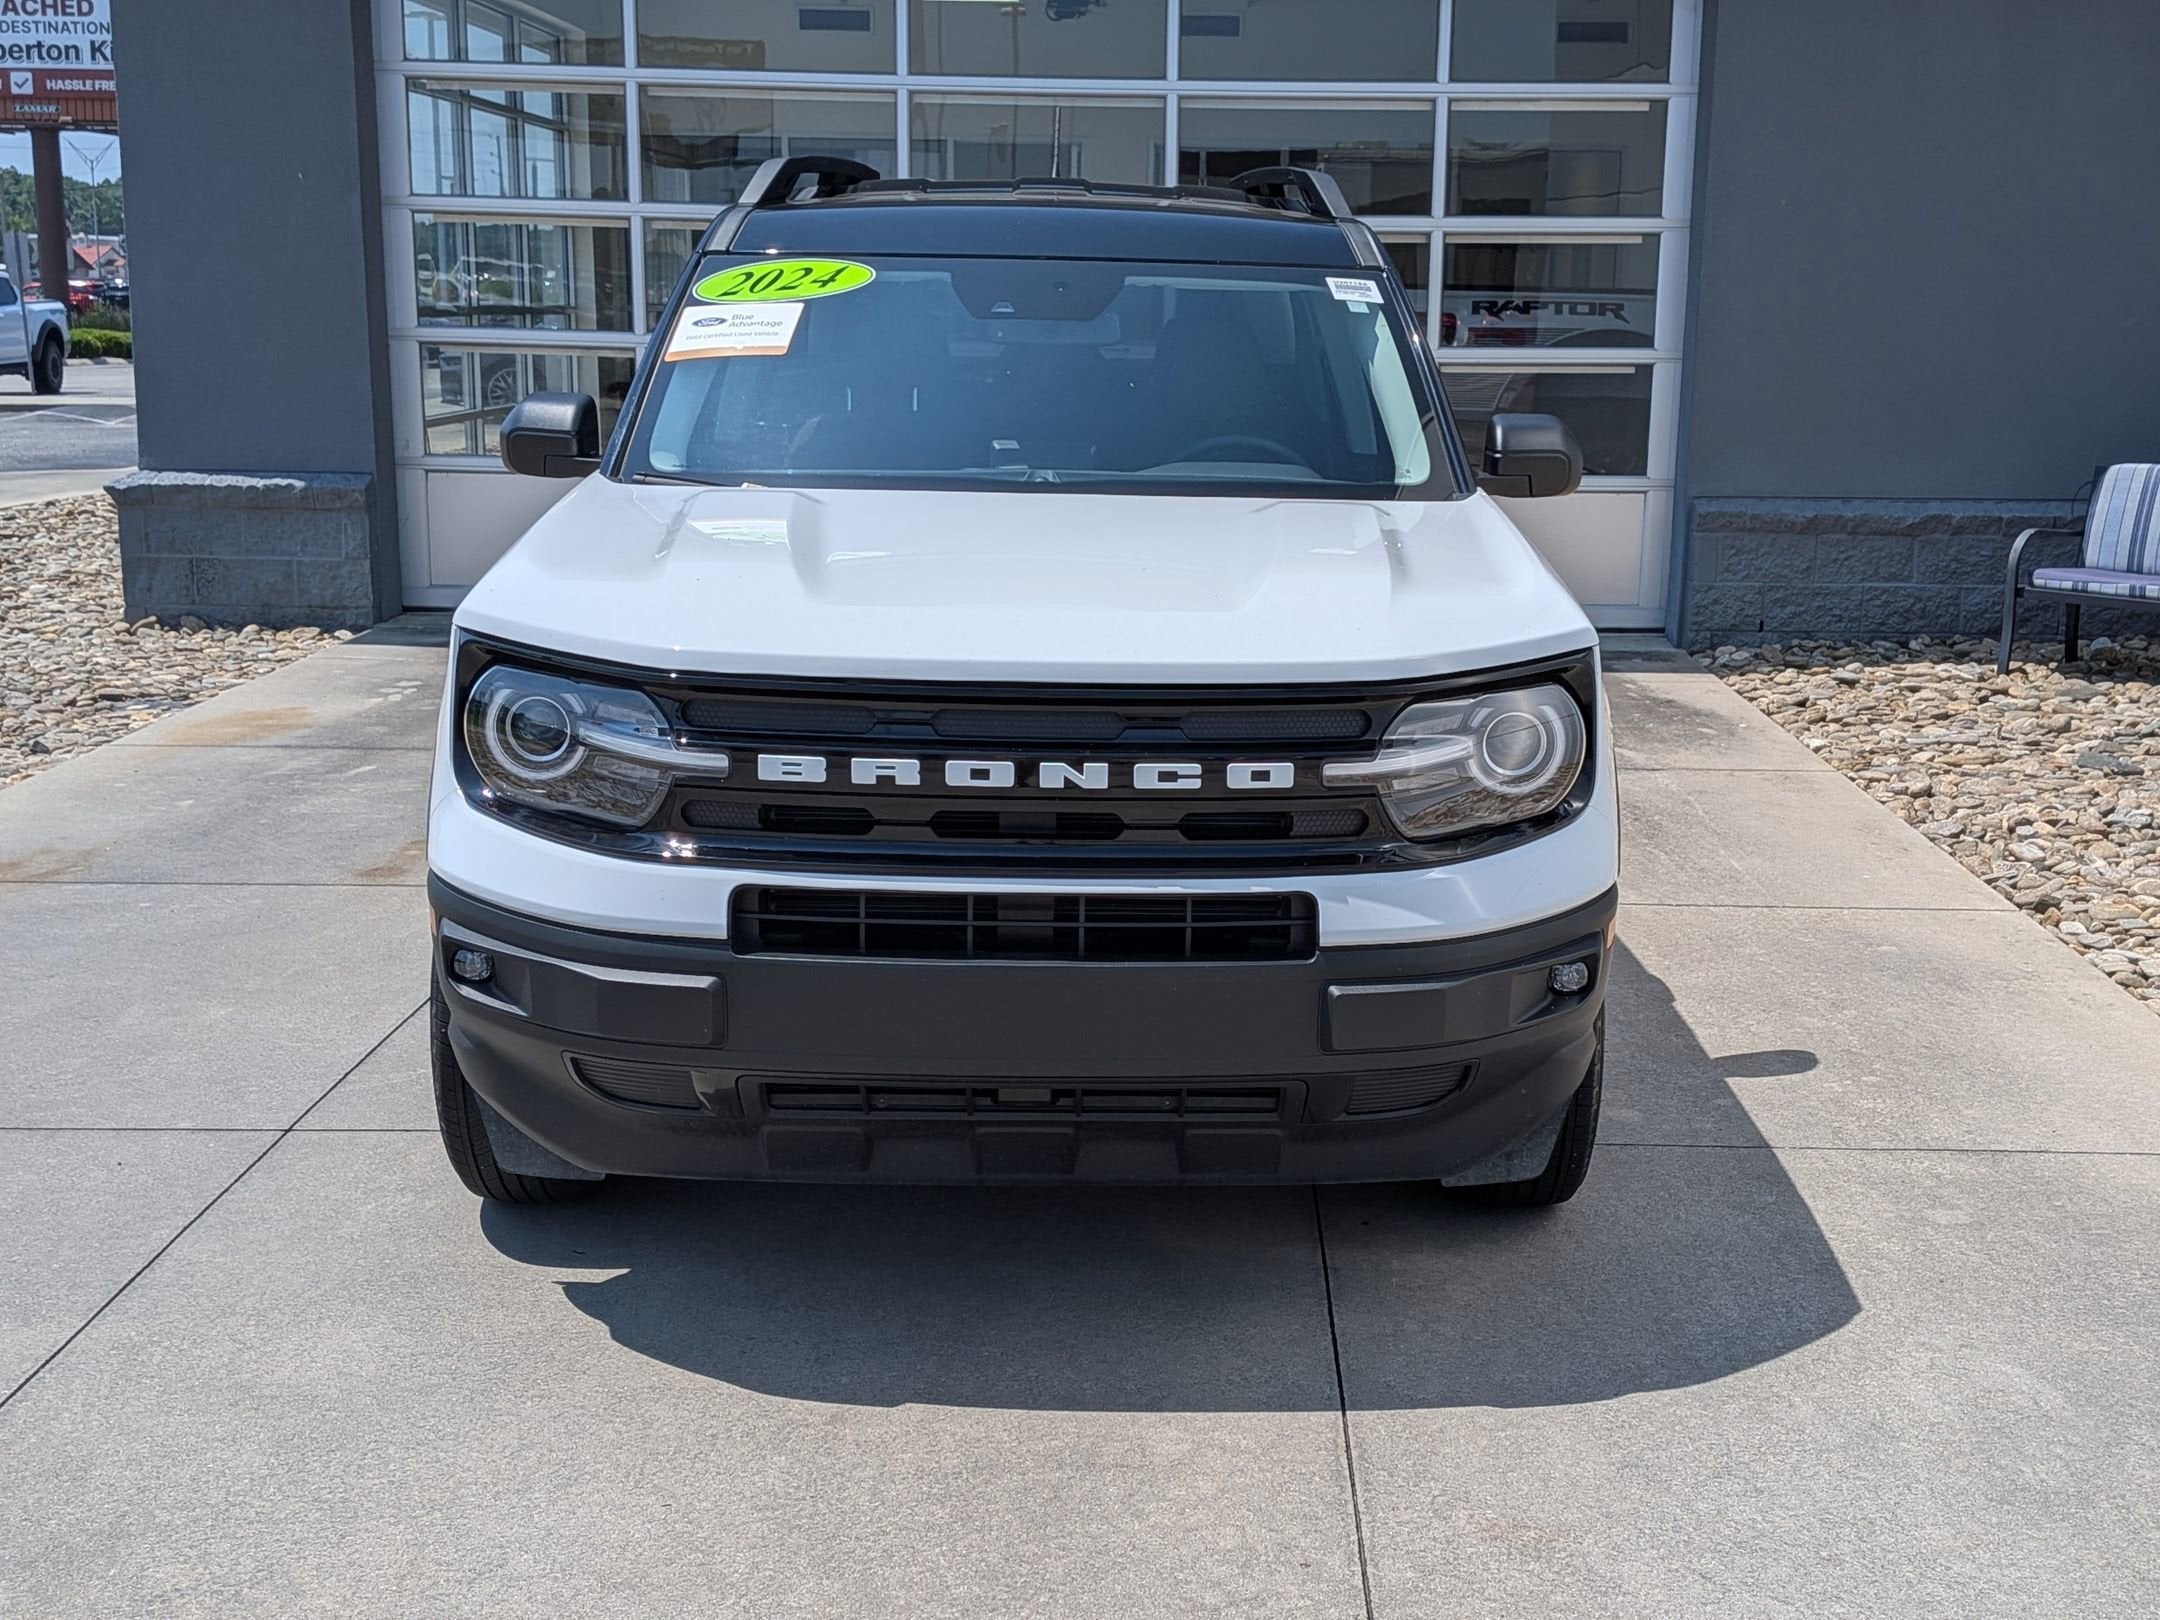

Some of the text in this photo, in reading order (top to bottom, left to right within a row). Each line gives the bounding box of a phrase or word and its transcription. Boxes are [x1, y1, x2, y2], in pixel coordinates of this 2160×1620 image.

[1, 0, 94, 17] ACHED
[0, 20, 111, 34] DESTINATION
[46, 79, 93, 91] HASSLE
[15, 104, 57, 113] LAMAR
[716, 265, 850, 298] 2024
[1471, 300, 1631, 324] RAPTOR
[728, 320, 784, 328] Advantage
[757, 753, 1294, 789] BRONCO
